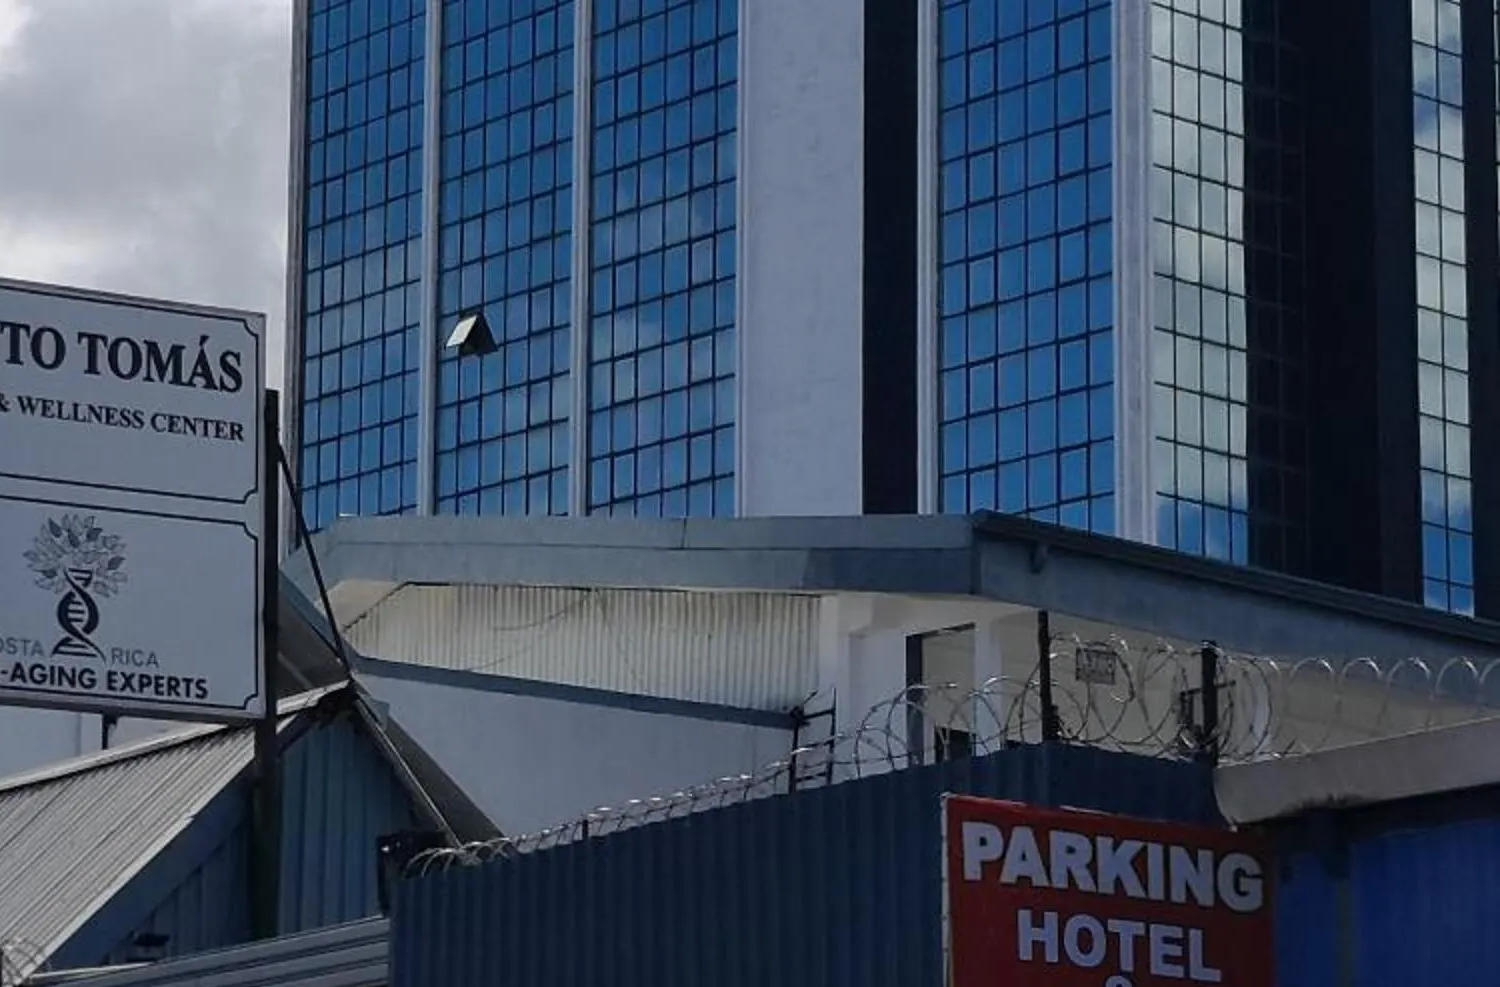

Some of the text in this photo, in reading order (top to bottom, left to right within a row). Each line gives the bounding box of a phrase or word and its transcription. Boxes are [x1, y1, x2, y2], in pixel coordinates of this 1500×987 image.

[77, 331, 243, 393] TOMÁS
[16, 394, 145, 430] WELLNESS
[150, 412, 245, 442] CENTER
[105, 670, 209, 700] EXPERTS
[111, 646, 160, 669] RICA
[961, 820, 1266, 913] PARKING
[1016, 908, 1222, 983] HOTEL
